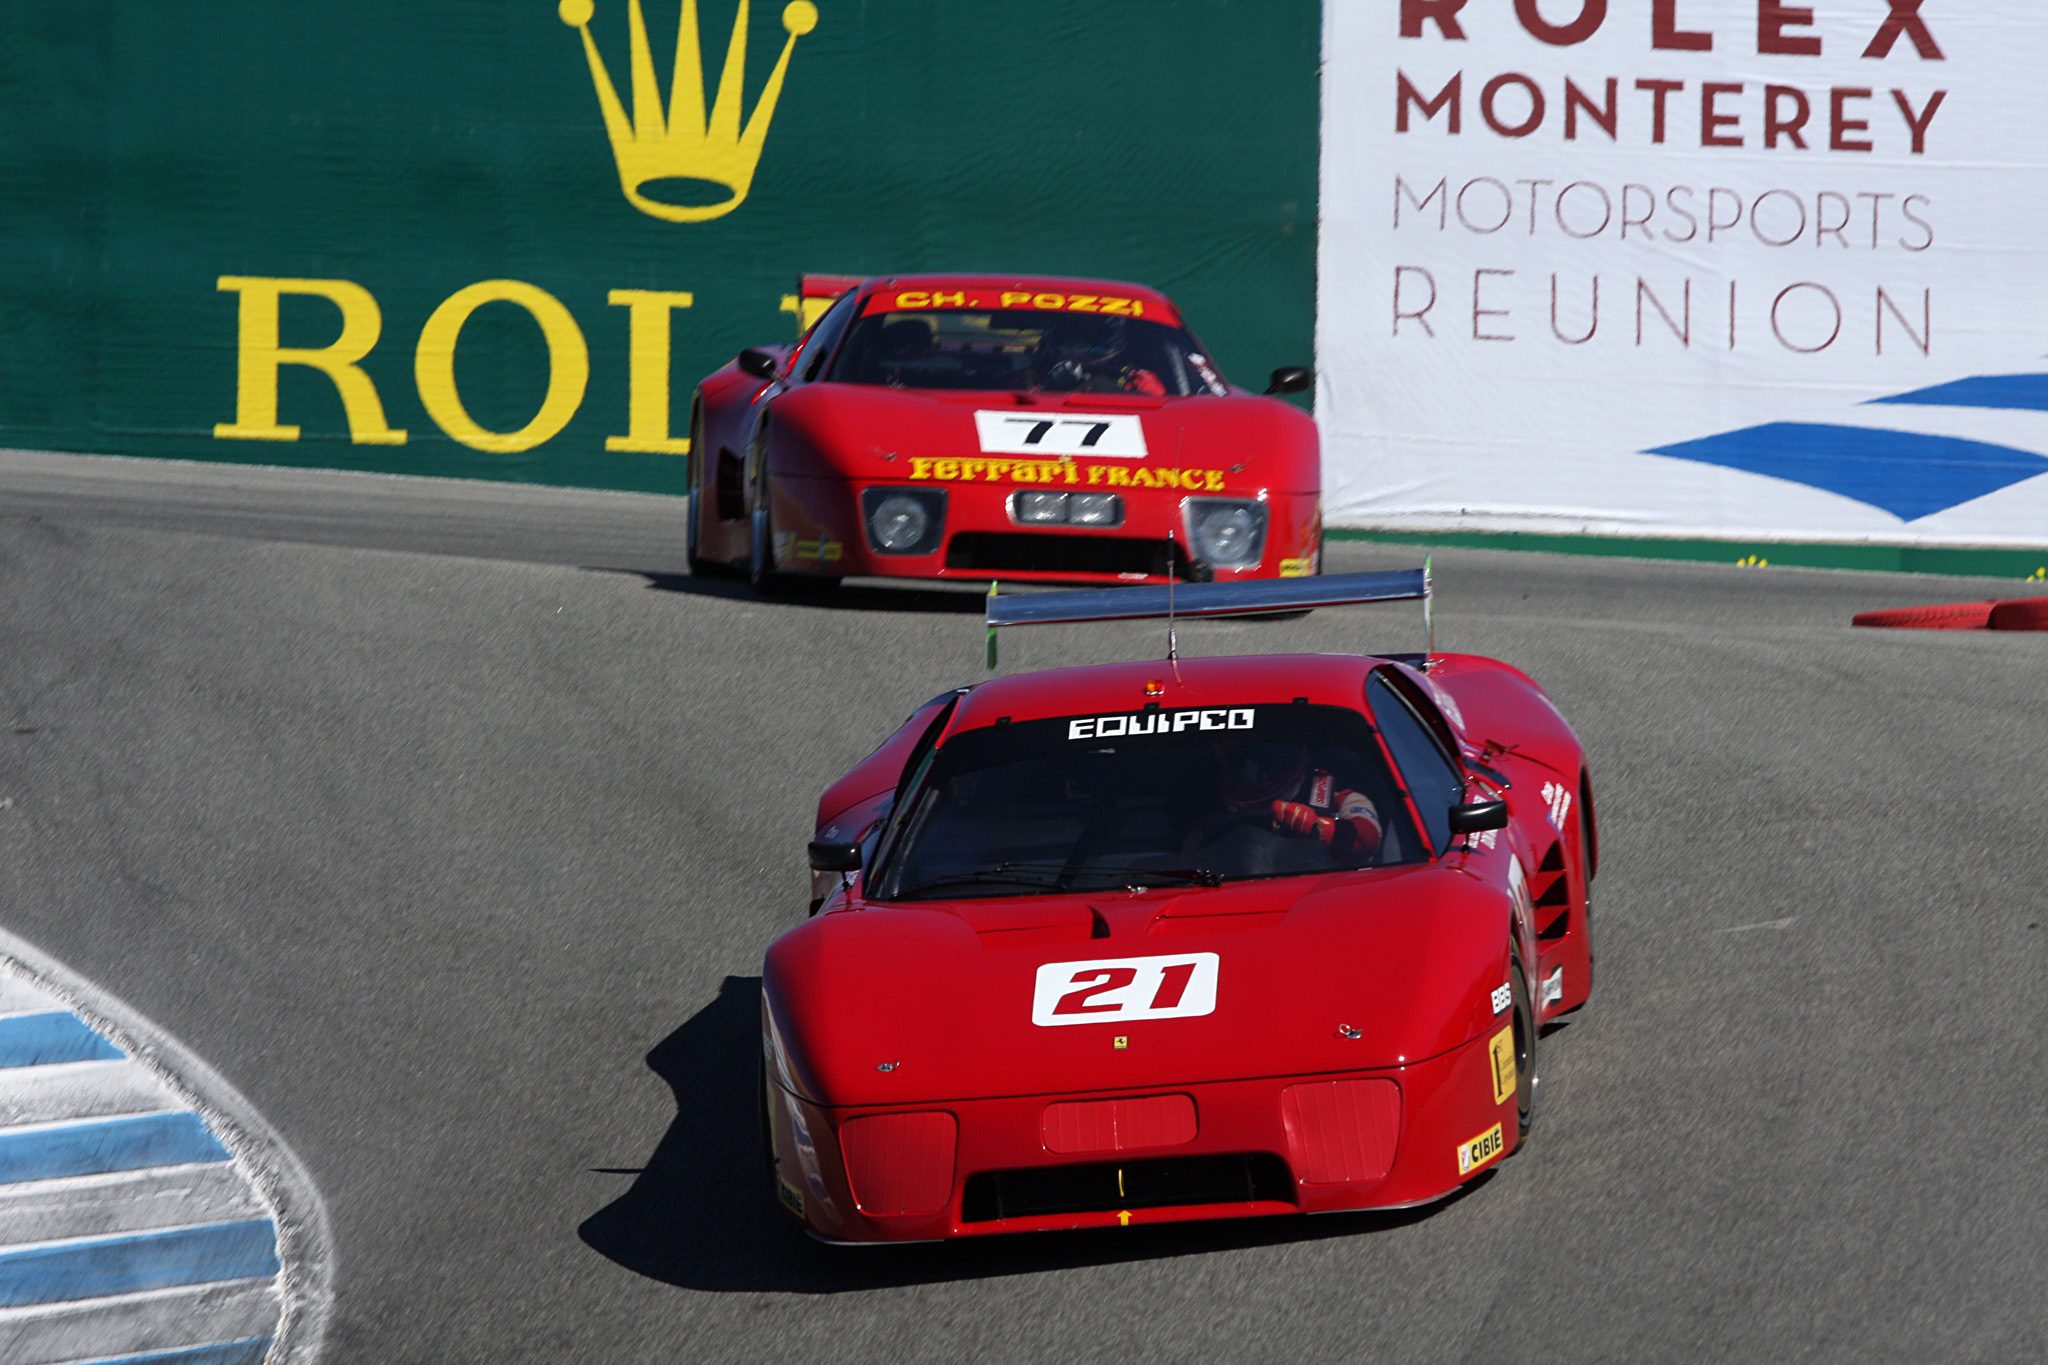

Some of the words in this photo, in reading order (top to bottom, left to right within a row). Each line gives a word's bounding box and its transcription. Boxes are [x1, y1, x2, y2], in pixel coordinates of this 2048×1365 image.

[1395, 69, 1948, 154] MONTEREY
[1393, 174, 1934, 251] MOTORSPORTS
[895, 291, 979, 308] CH.
[1000, 291, 1145, 317] POZZI
[1392, 265, 1930, 357] REUNION
[1003, 418, 1112, 447] 77
[908, 456, 1081, 483] Ferrari
[1087, 465, 1226, 491] FRANCE
[1067, 708, 1256, 740] EQUIPCO
[1052, 962, 1197, 1015] 21
[1490, 981, 1512, 1014] BBS
[1471, 1128, 1502, 1163] CIBIE
